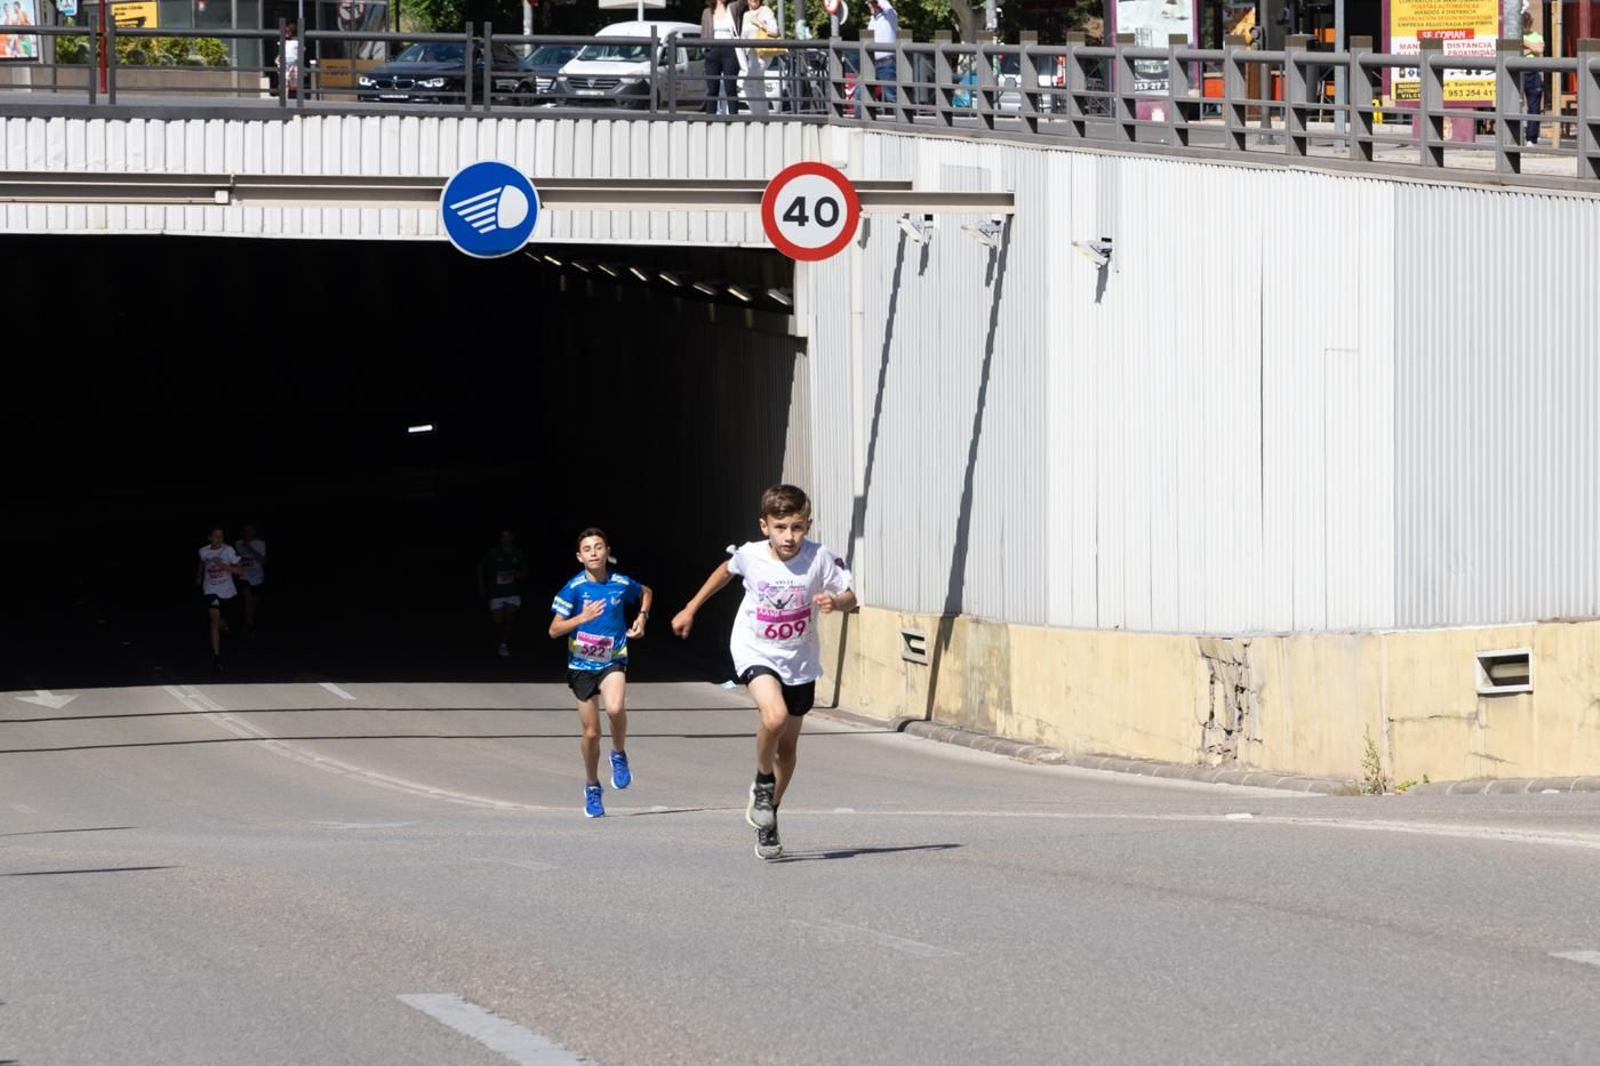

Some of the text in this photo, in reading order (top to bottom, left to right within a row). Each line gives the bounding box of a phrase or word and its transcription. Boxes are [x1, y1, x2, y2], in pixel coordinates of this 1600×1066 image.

[1434, 30, 1466, 39] COPIAN
[1448, 89, 1464, 97] 953
[1465, 89, 1481, 97] 254
[782, 196, 840, 228] 40
[764, 620, 806, 640] 609
[582, 644, 606, 657] 522
